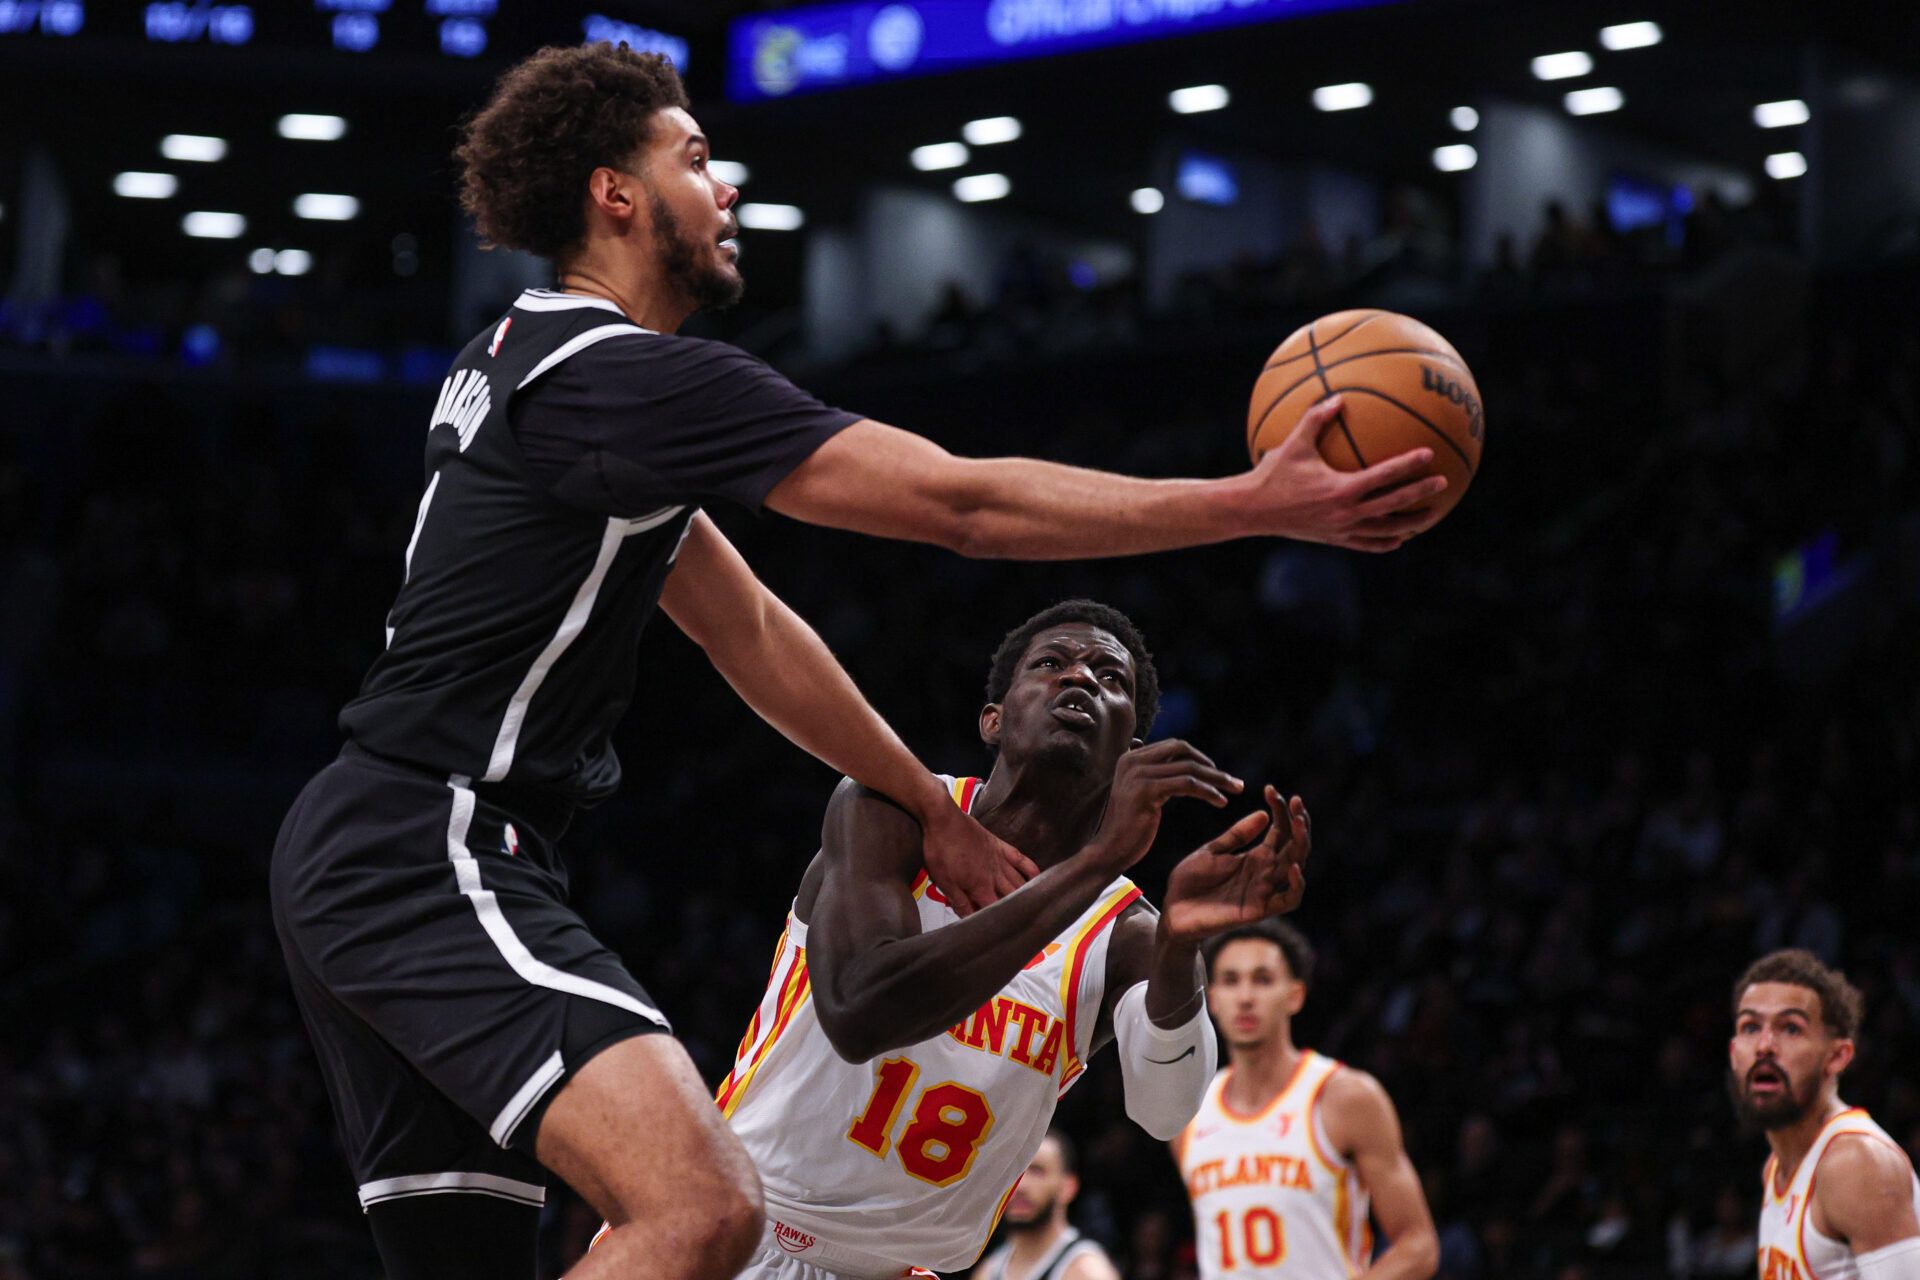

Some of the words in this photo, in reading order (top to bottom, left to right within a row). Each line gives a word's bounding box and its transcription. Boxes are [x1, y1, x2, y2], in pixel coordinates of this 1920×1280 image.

[430, 369, 491, 453] OHNSON
[847, 1056, 996, 1188] 18
[1188, 1154, 1313, 1199] ATLANTA
[773, 1221, 817, 1248] HAWKS
[1214, 1205, 1286, 1273] 10
